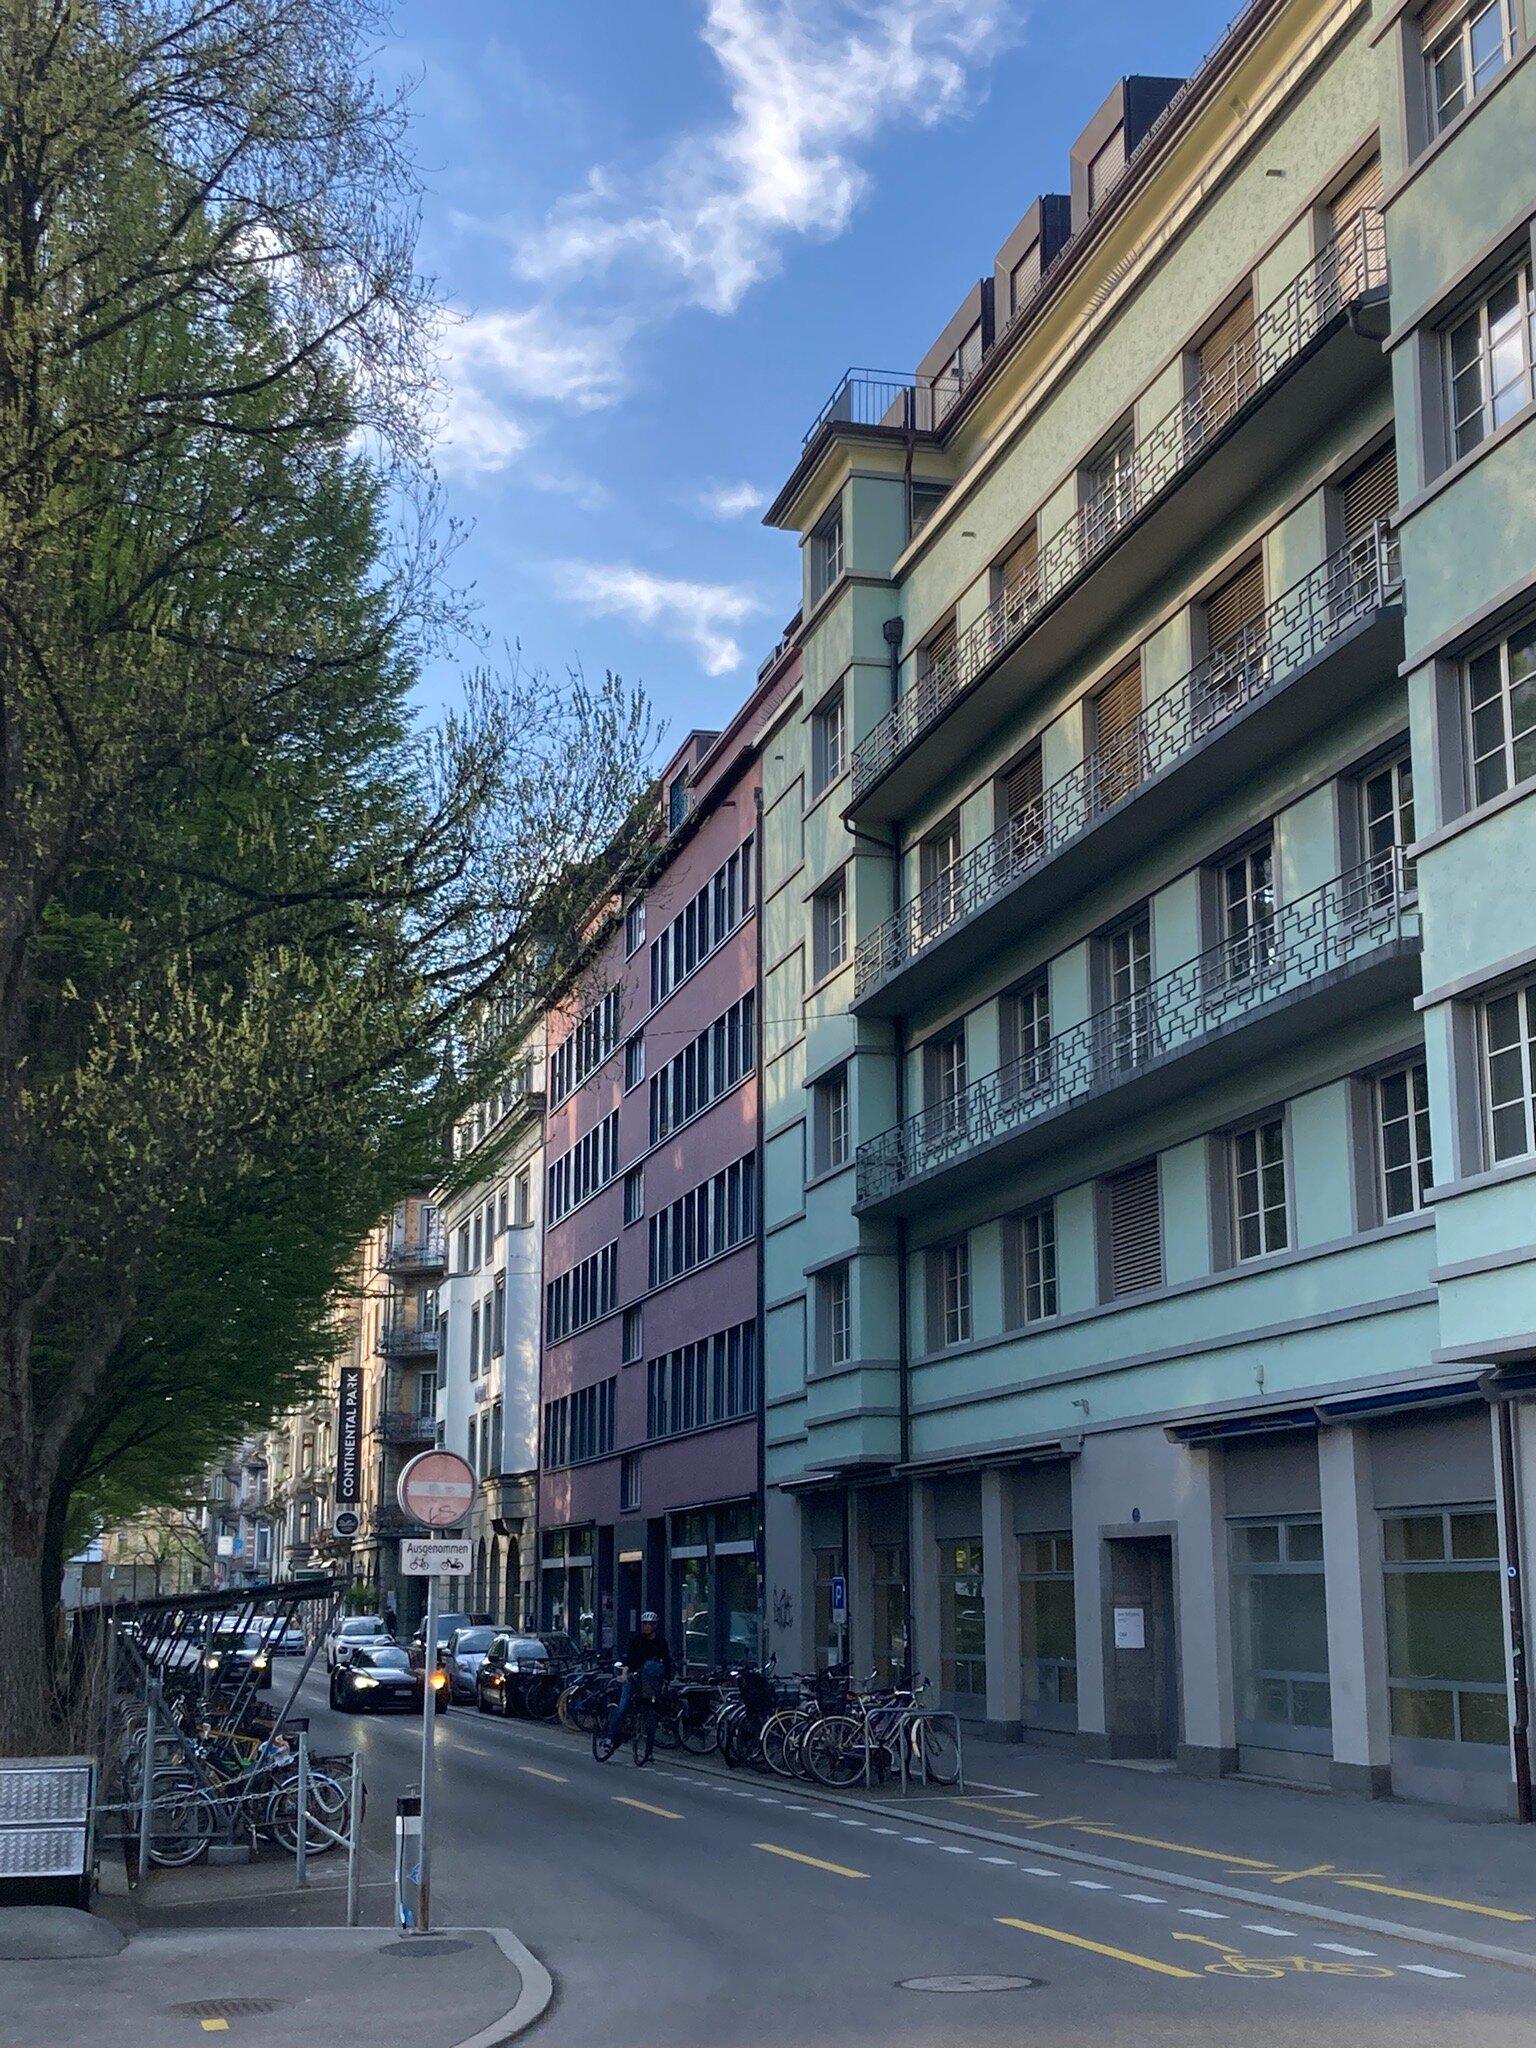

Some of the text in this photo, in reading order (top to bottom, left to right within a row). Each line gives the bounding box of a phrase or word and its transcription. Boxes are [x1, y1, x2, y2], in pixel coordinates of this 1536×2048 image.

[346, 1373, 359, 1406] PARK
[343, 1408, 357, 1497] CONTINENTAL
[407, 1542, 469, 1557] Ausgenommen
[835, 1585, 843, 1607] P
